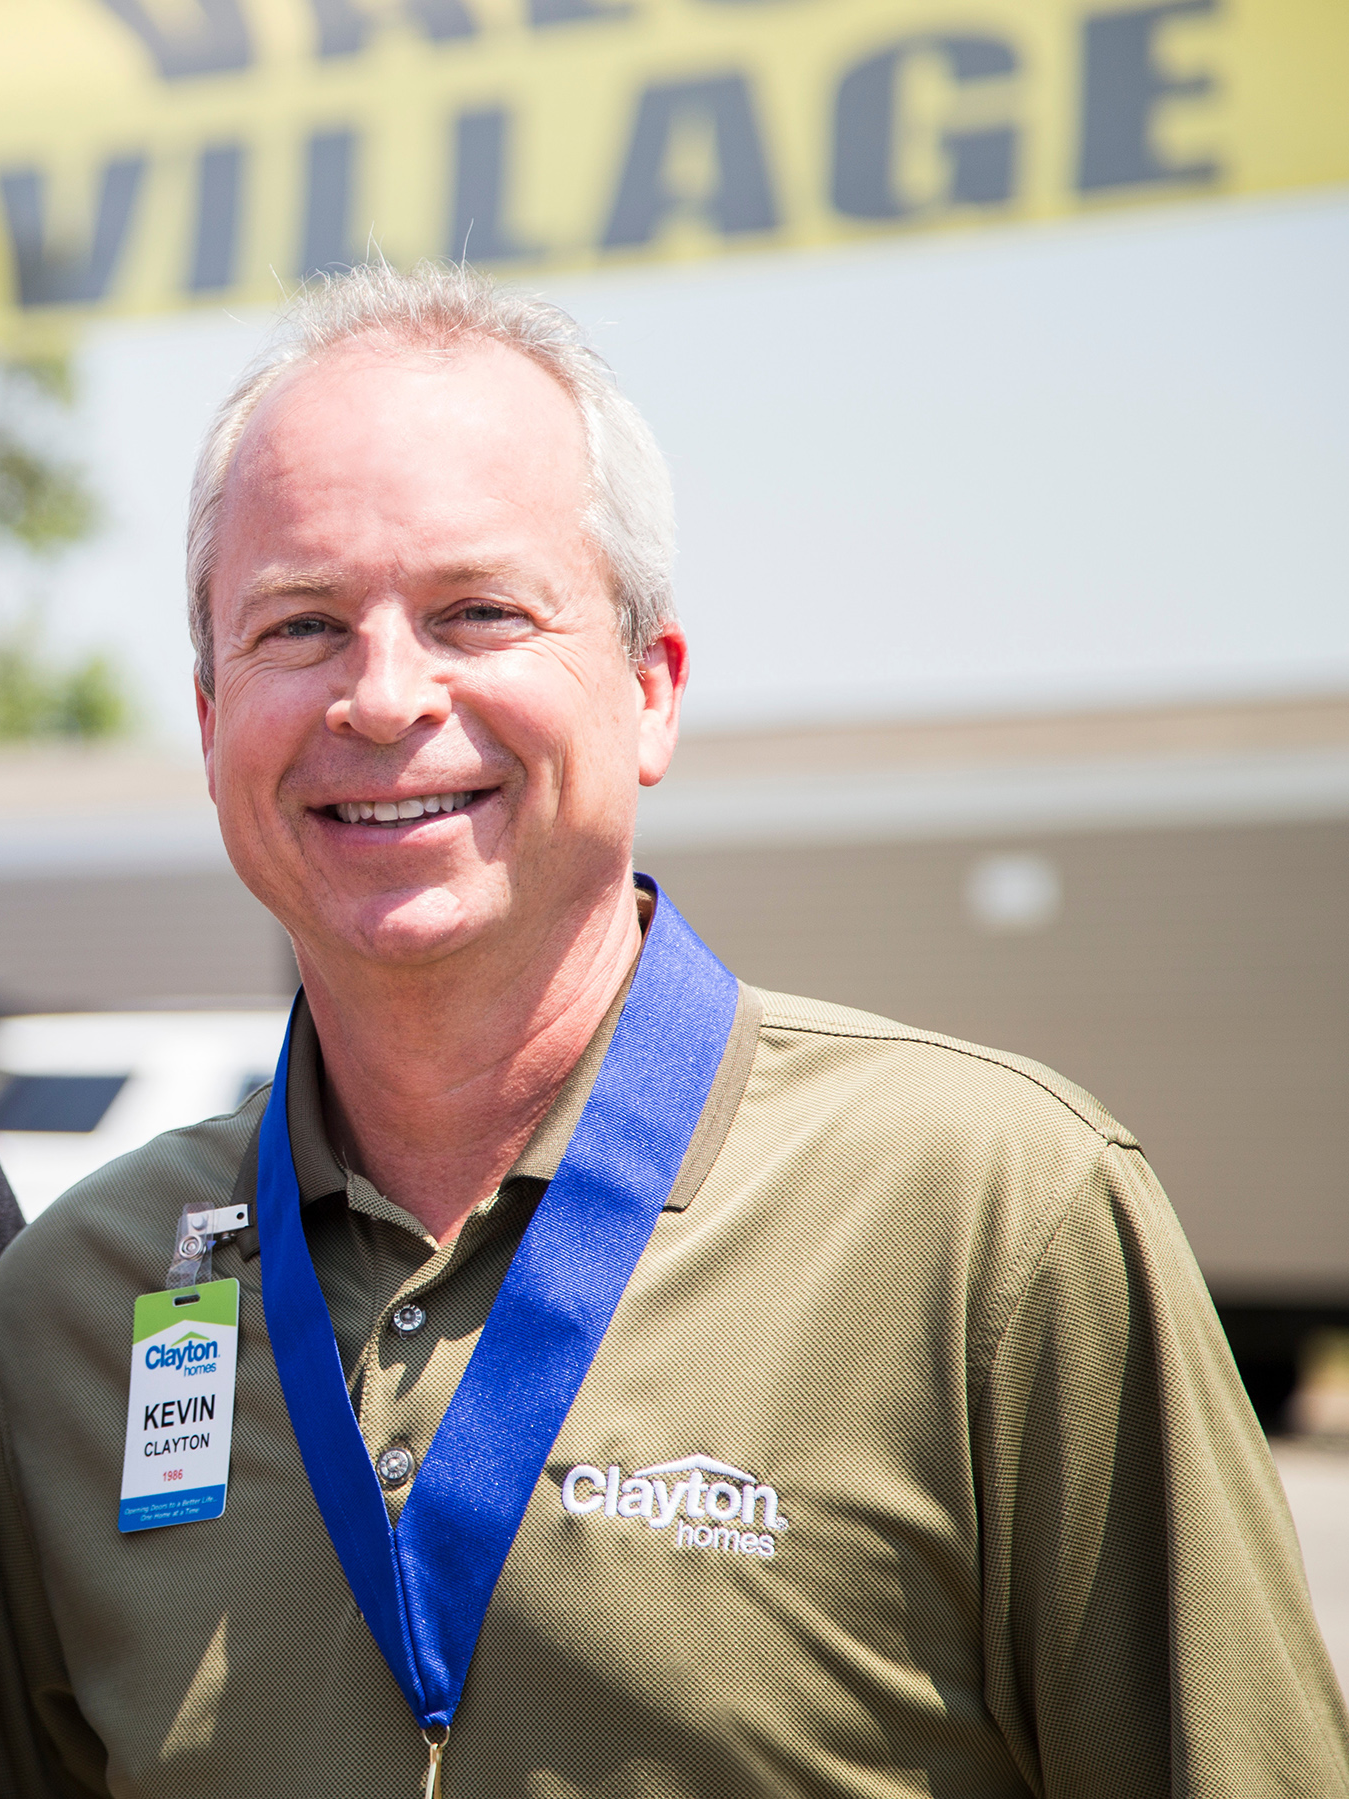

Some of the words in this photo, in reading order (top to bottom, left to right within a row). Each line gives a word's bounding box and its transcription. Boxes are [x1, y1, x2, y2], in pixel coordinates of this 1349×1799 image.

[145, 1340, 218, 1370] Clayton
[183, 1362, 217, 1377] homes
[143, 1394, 215, 1431] KEVIN
[144, 1432, 210, 1457] CLAYTON
[162, 1468, 183, 1481] 1986
[150, 1504, 167, 1512] Doors
[169, 1501, 176, 1509] to
[561, 1464, 779, 1529] Clayton
[154, 1512, 171, 1520] Home
[677, 1519, 776, 1557] homes
